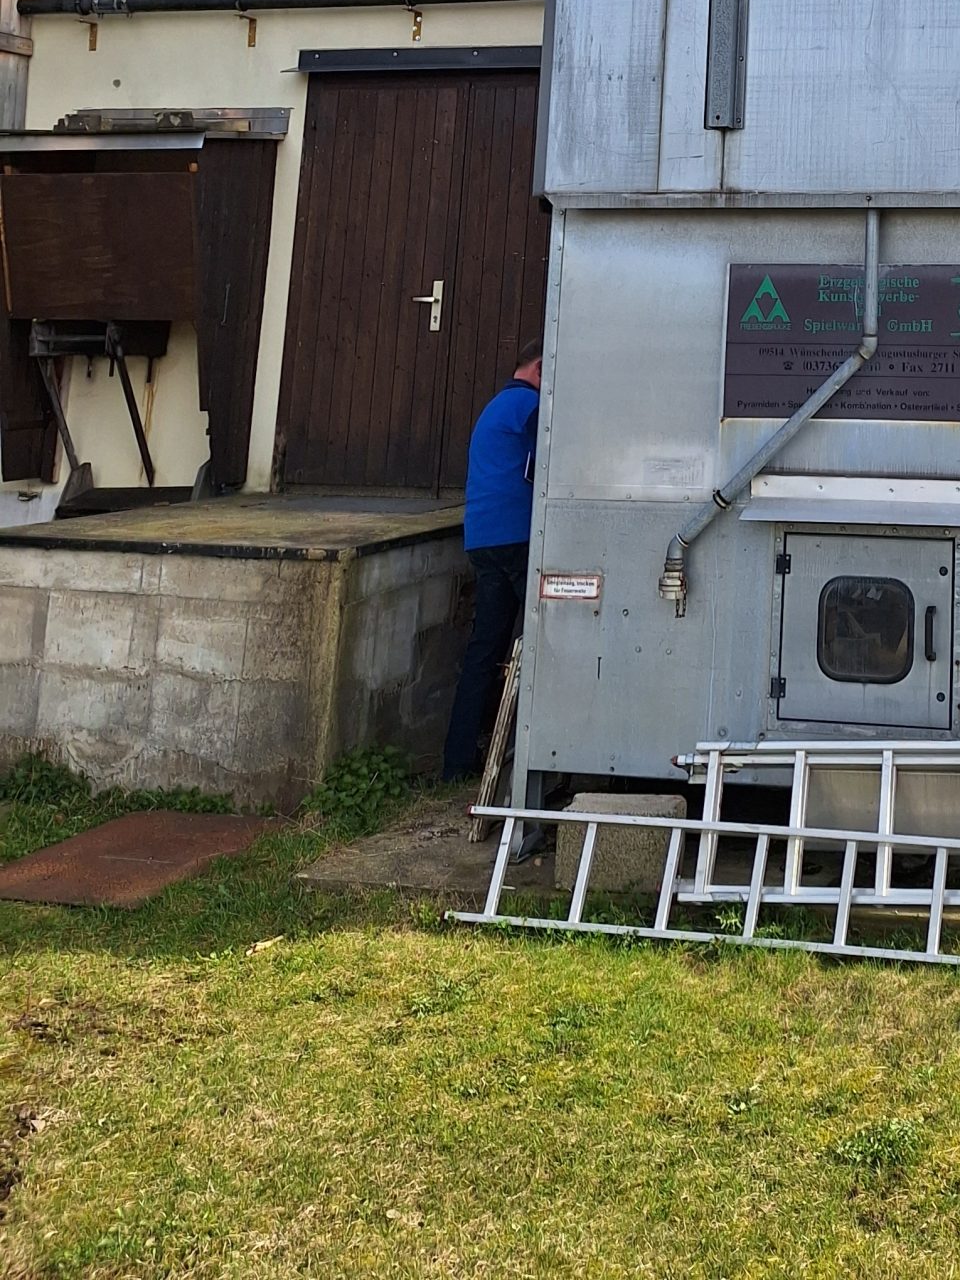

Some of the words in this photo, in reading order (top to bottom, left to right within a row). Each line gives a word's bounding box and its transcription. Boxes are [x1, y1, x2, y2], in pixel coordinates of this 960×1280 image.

[887, 319, 933, 332] GmbH
[902, 362, 924, 373] Fax
[931, 362, 955, 373] 2711
[876, 388, 909, 397] Verkauf
[737, 401, 780, 409] Pyramiden
[900, 402, 949, 411] Osterartikel
